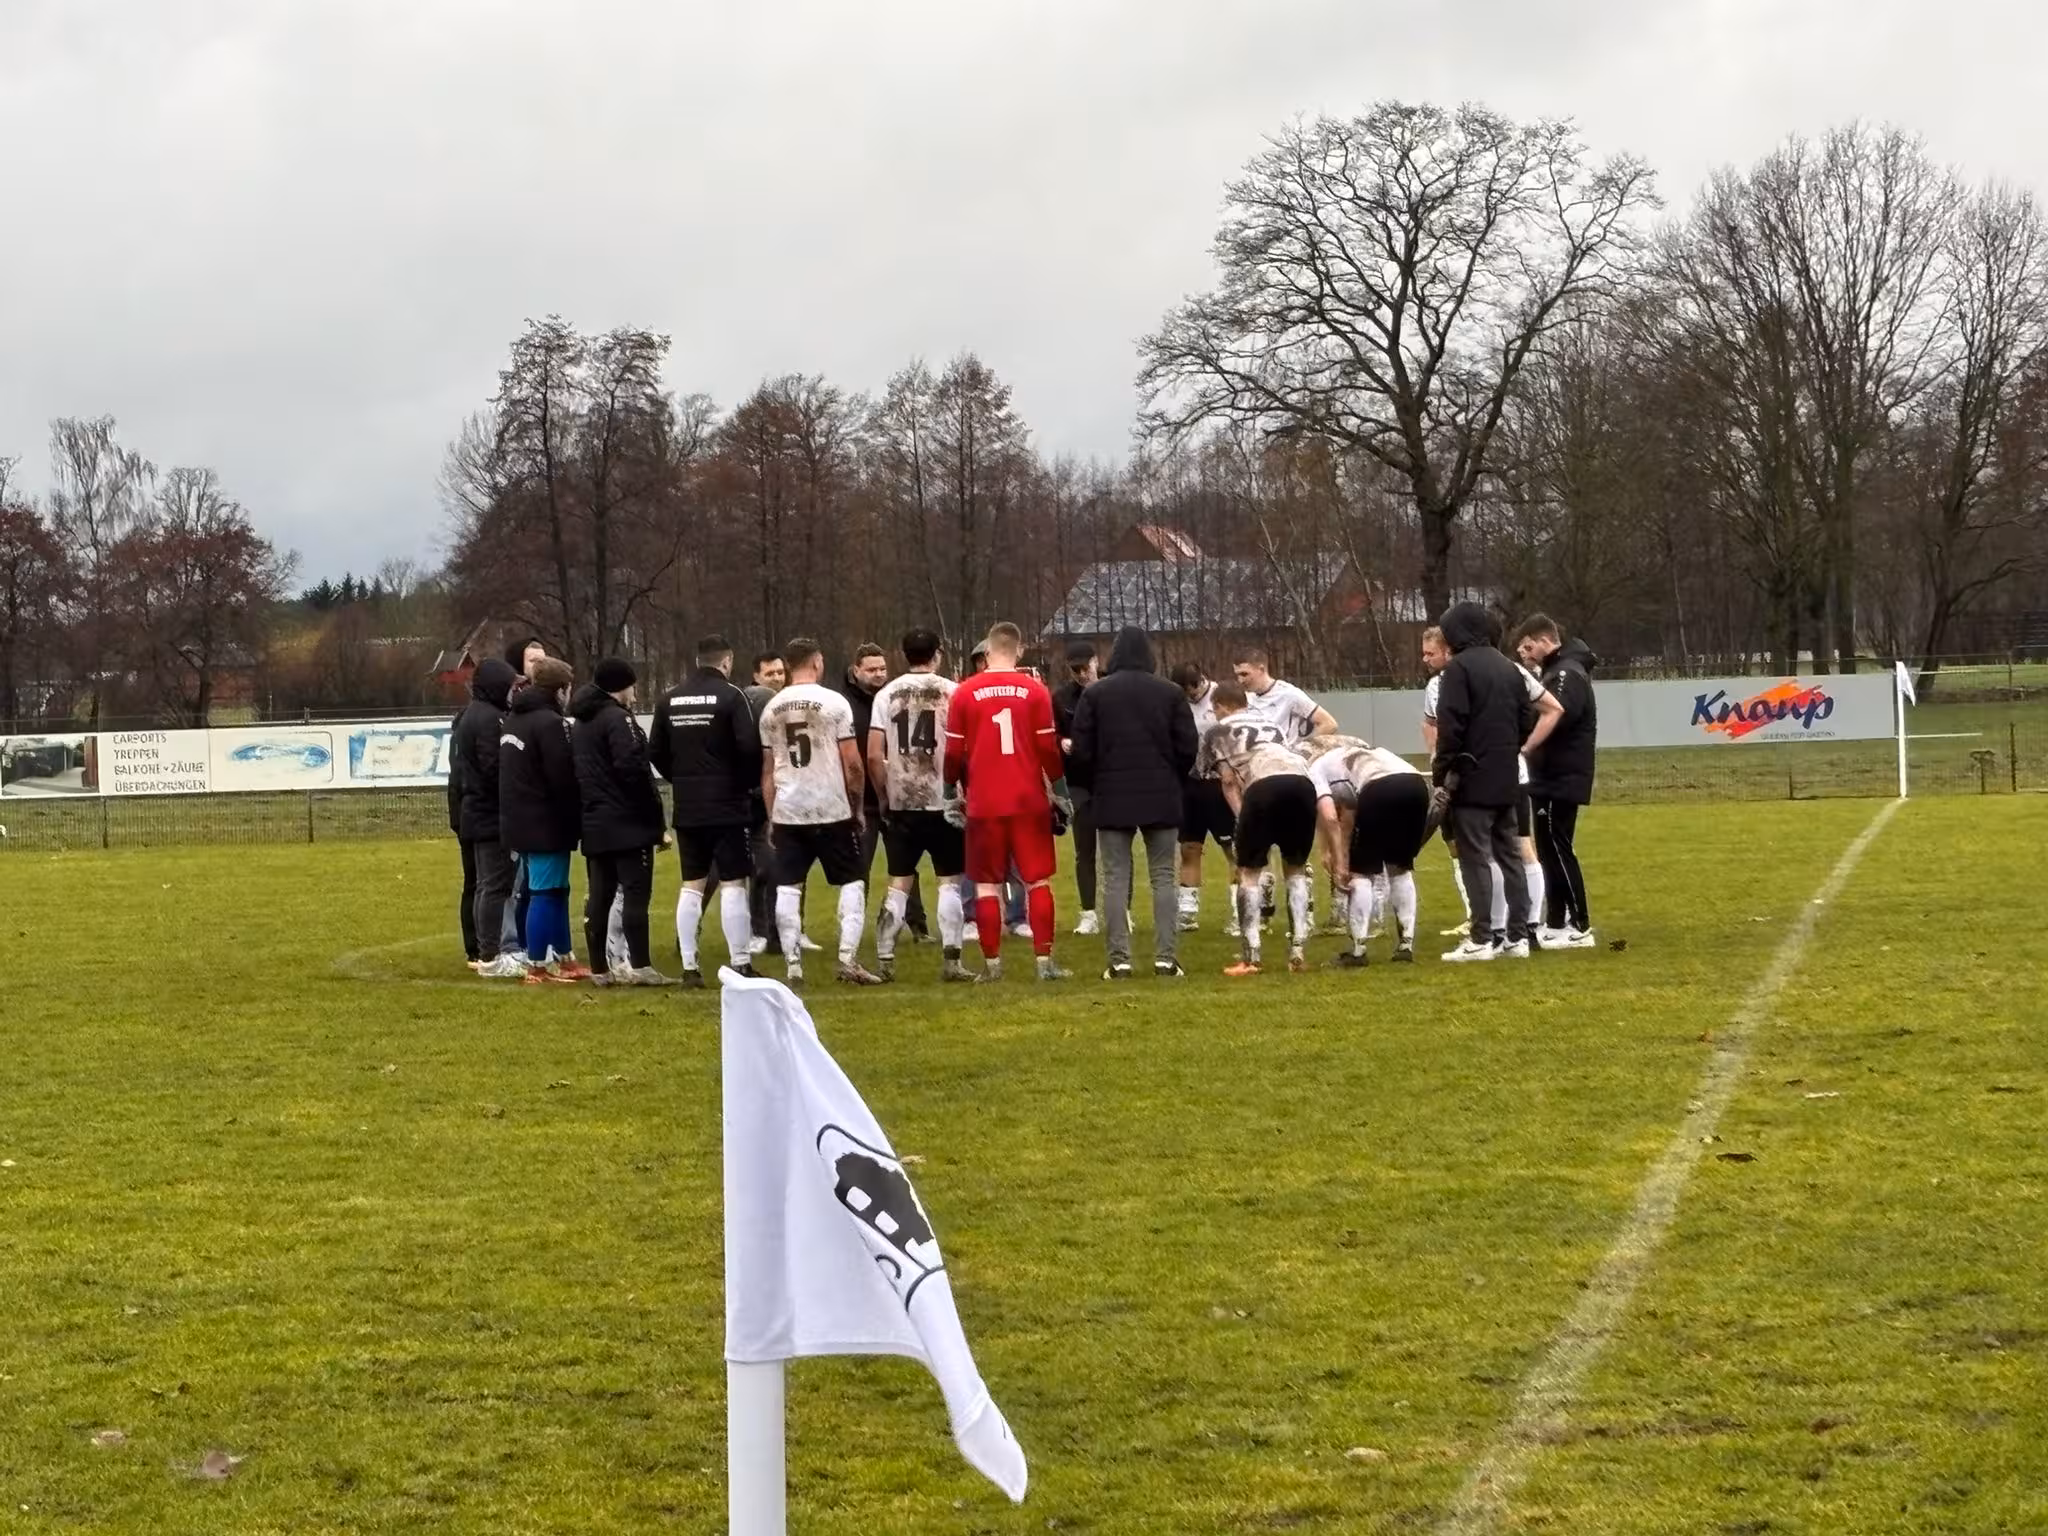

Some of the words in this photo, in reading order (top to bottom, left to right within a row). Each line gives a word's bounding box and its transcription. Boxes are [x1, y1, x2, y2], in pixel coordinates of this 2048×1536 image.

[1691, 690, 1834, 729] Knaup
[113, 733, 167, 744] CARPORTS
[786, 722, 811, 768] 5
[891, 709, 938, 755] 14
[992, 708, 1015, 754] 1
[113, 749, 159, 760] TREPPEN
[115, 780, 206, 793] ÜBERDACHUNGEN
